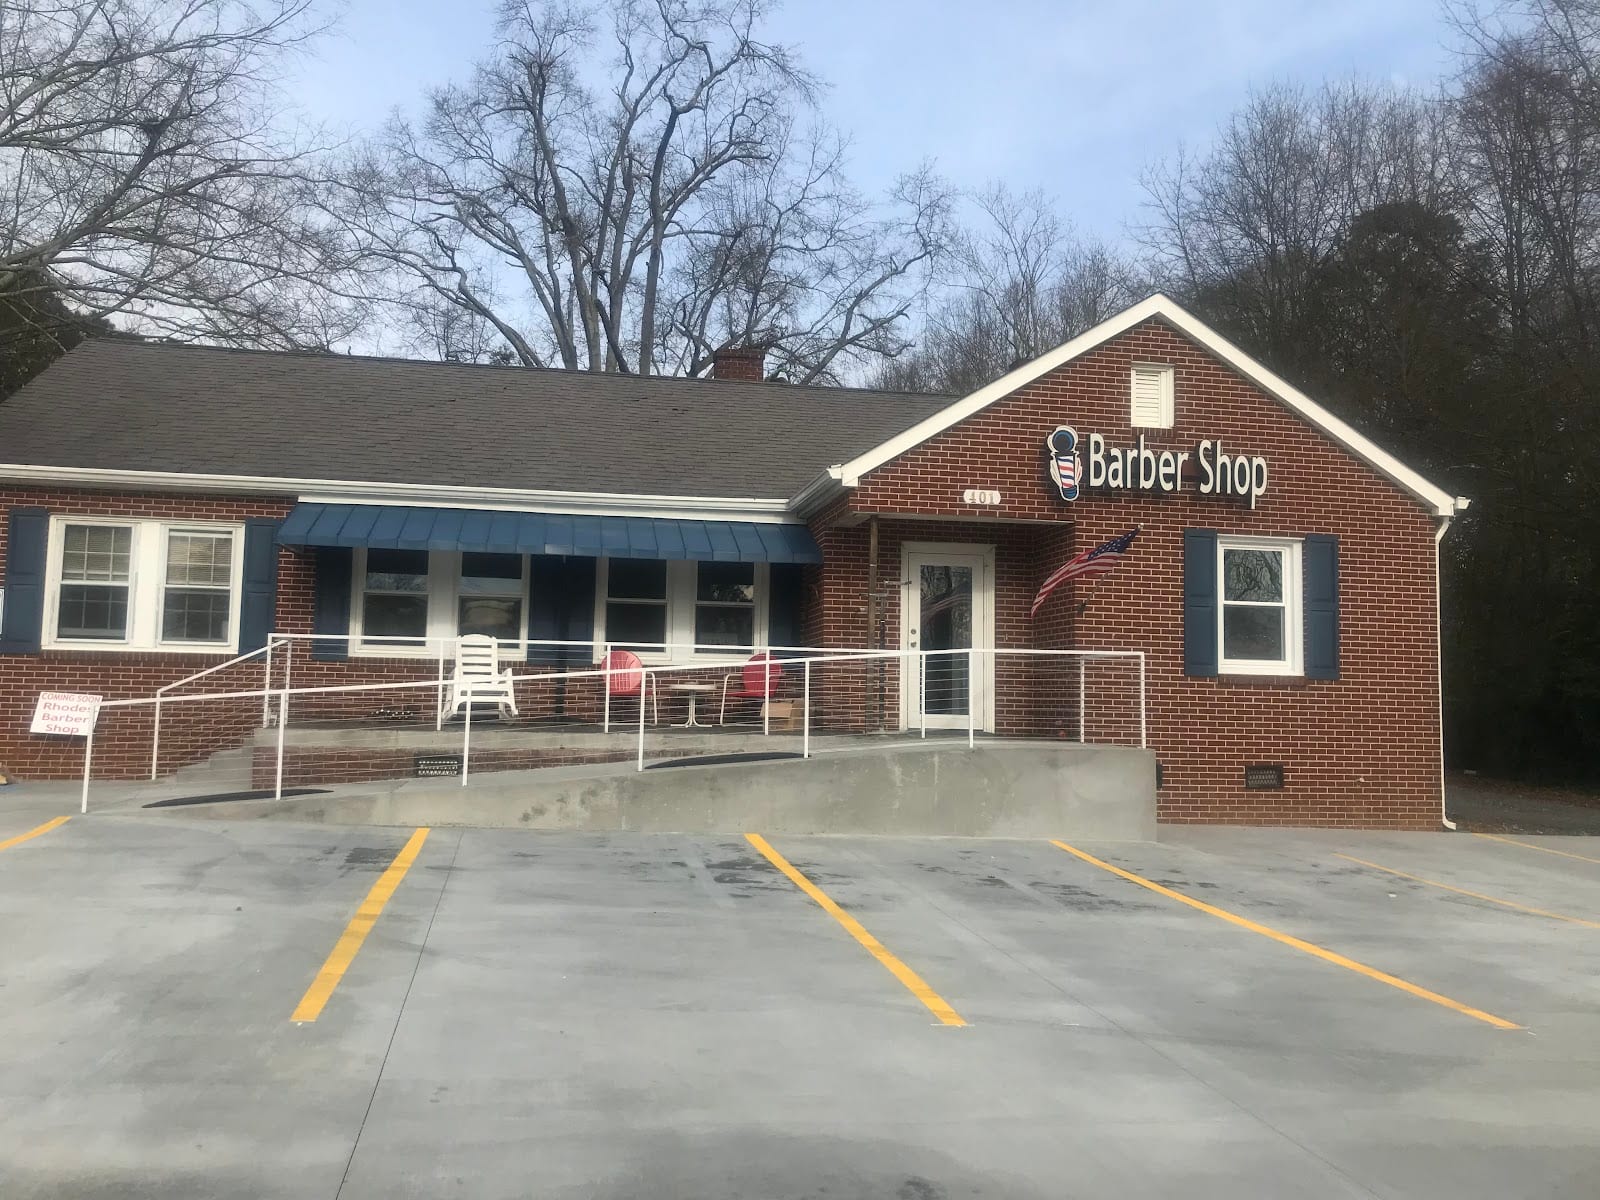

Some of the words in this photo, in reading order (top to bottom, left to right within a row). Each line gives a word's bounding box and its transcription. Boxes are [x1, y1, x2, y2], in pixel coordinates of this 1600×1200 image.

[1089, 433, 1189, 491] Barber
[1198, 439, 1268, 509] Shop
[968, 491, 995, 504] 401
[41, 692, 75, 702] COMING
[77, 695, 101, 703] SOON
[42, 712, 89, 723] Barber
[45, 724, 79, 735] Shop
